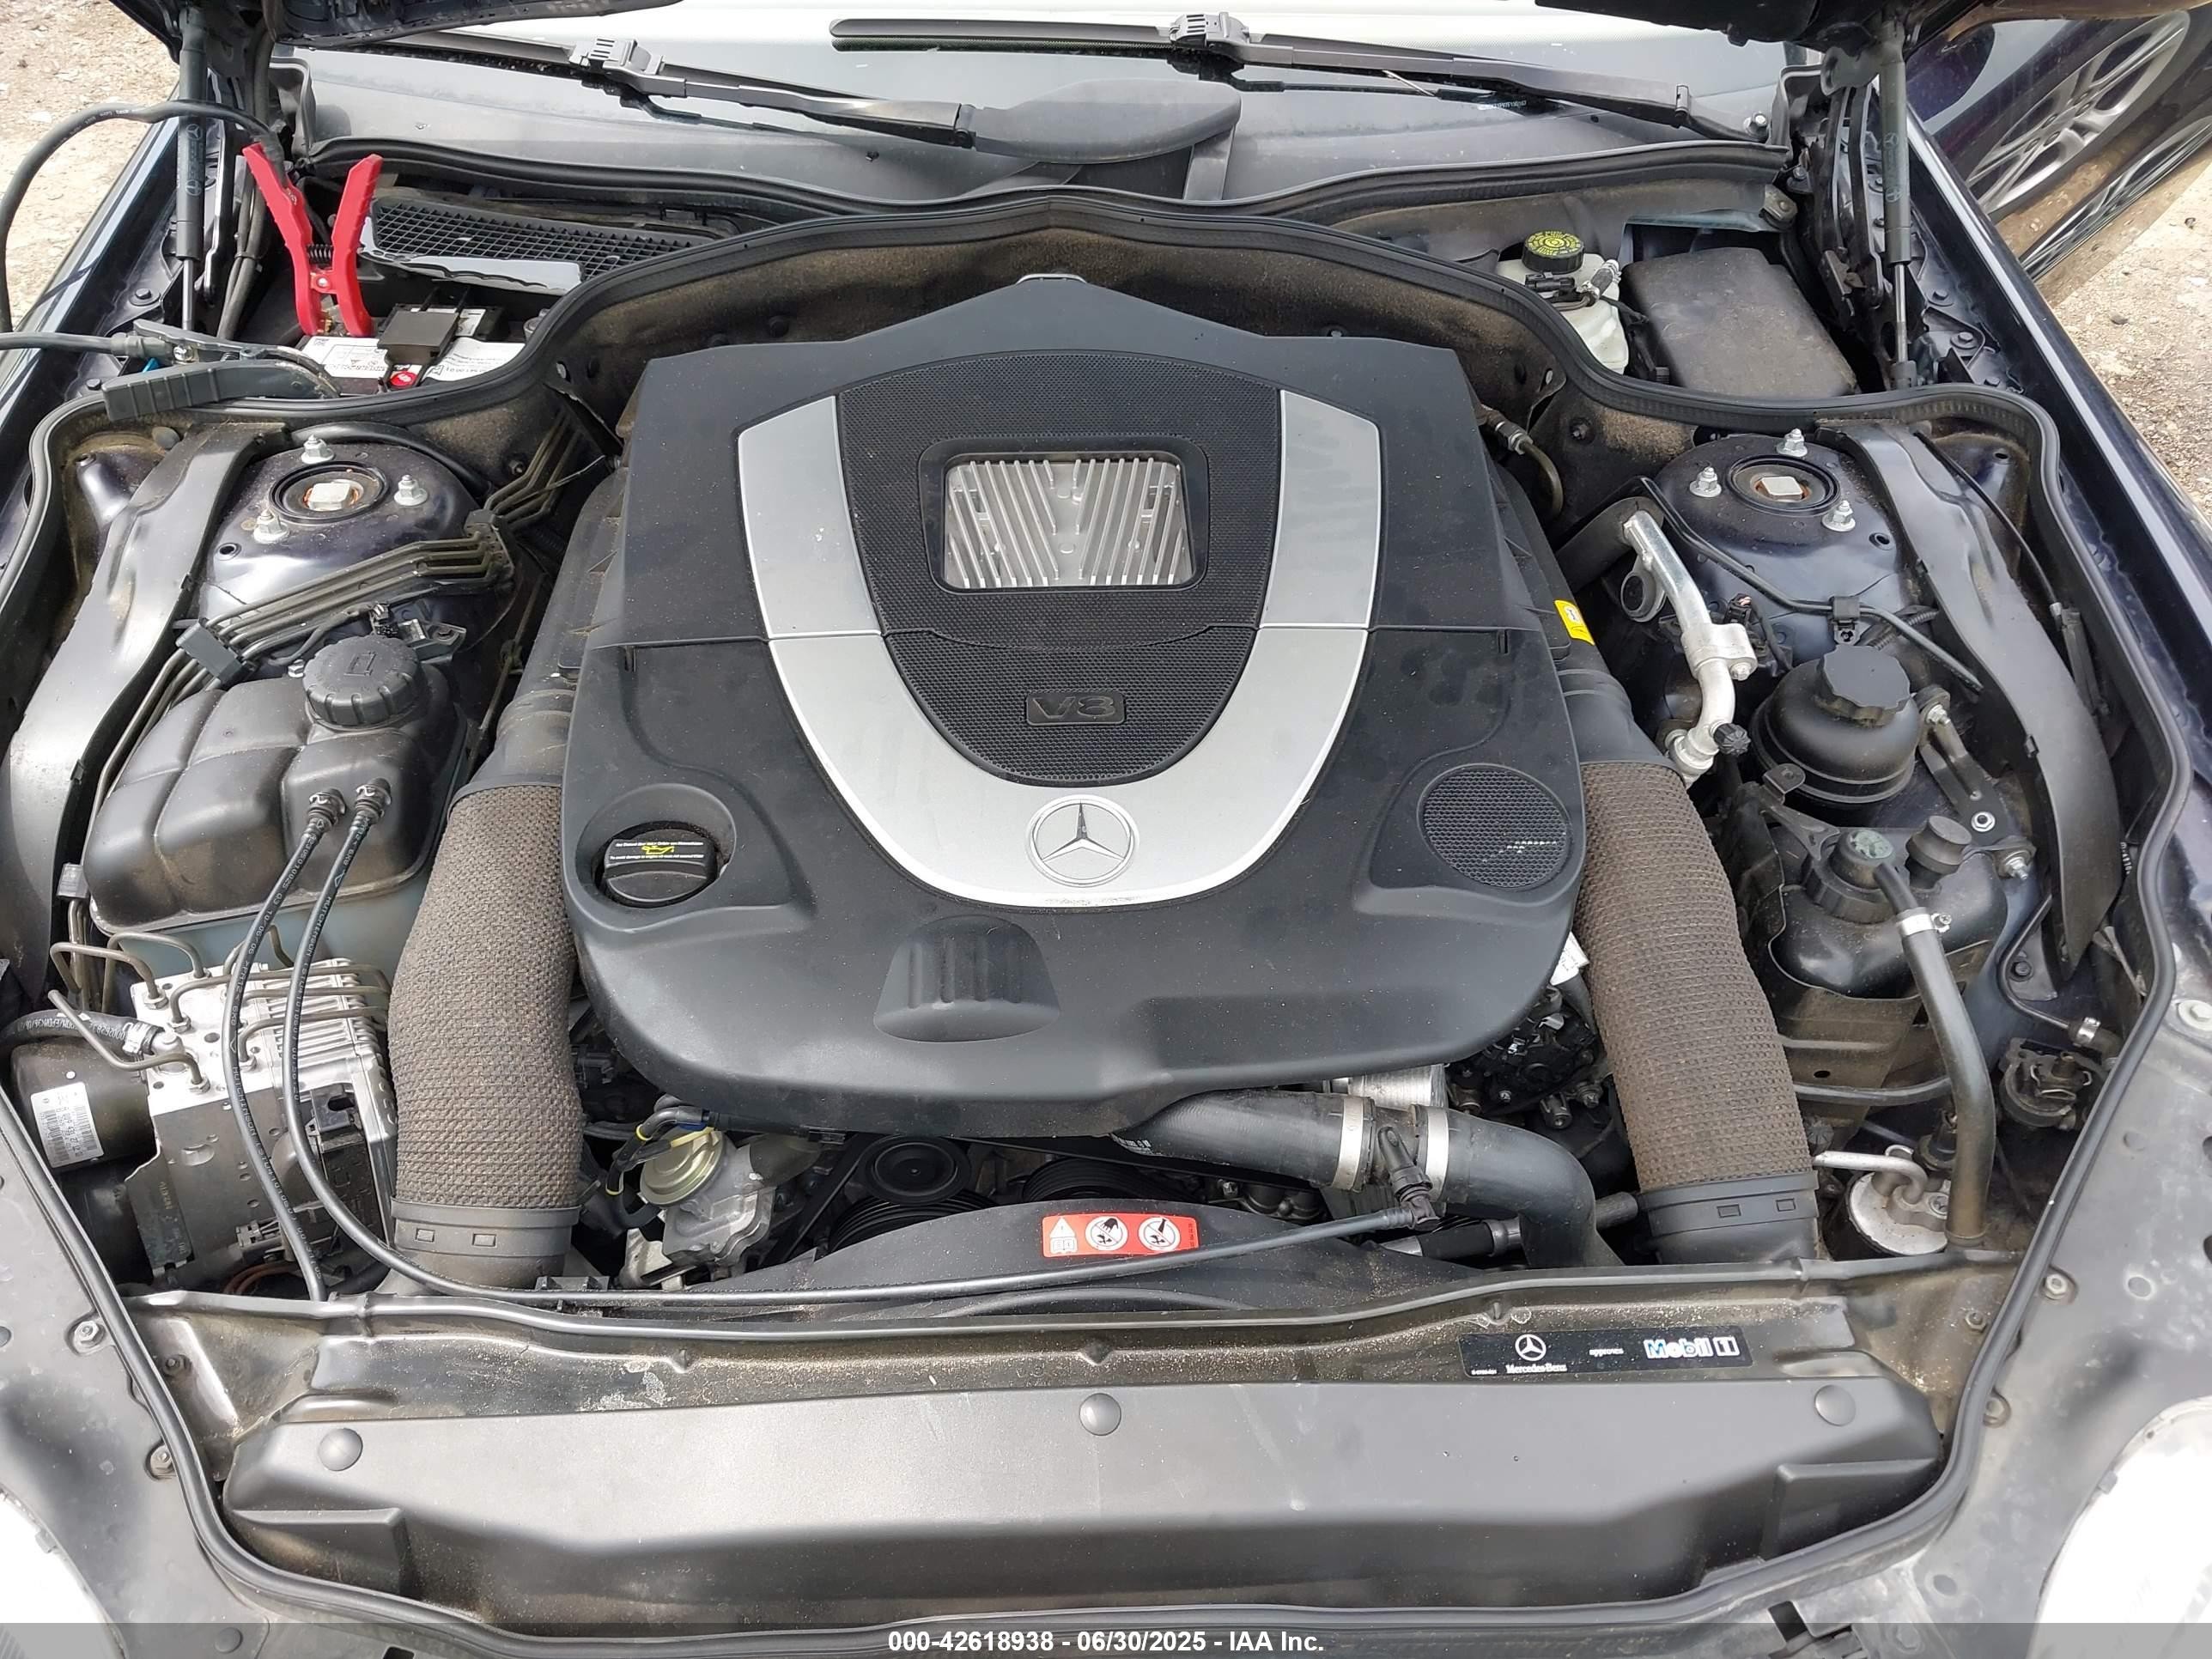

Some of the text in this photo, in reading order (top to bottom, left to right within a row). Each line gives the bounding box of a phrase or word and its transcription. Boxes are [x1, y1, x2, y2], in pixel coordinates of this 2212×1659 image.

[1032, 696, 1116, 719] V8
[1644, 1338, 1714, 1360] Mobil
[1505, 1363, 1568, 1374] Mercedes-Benz
